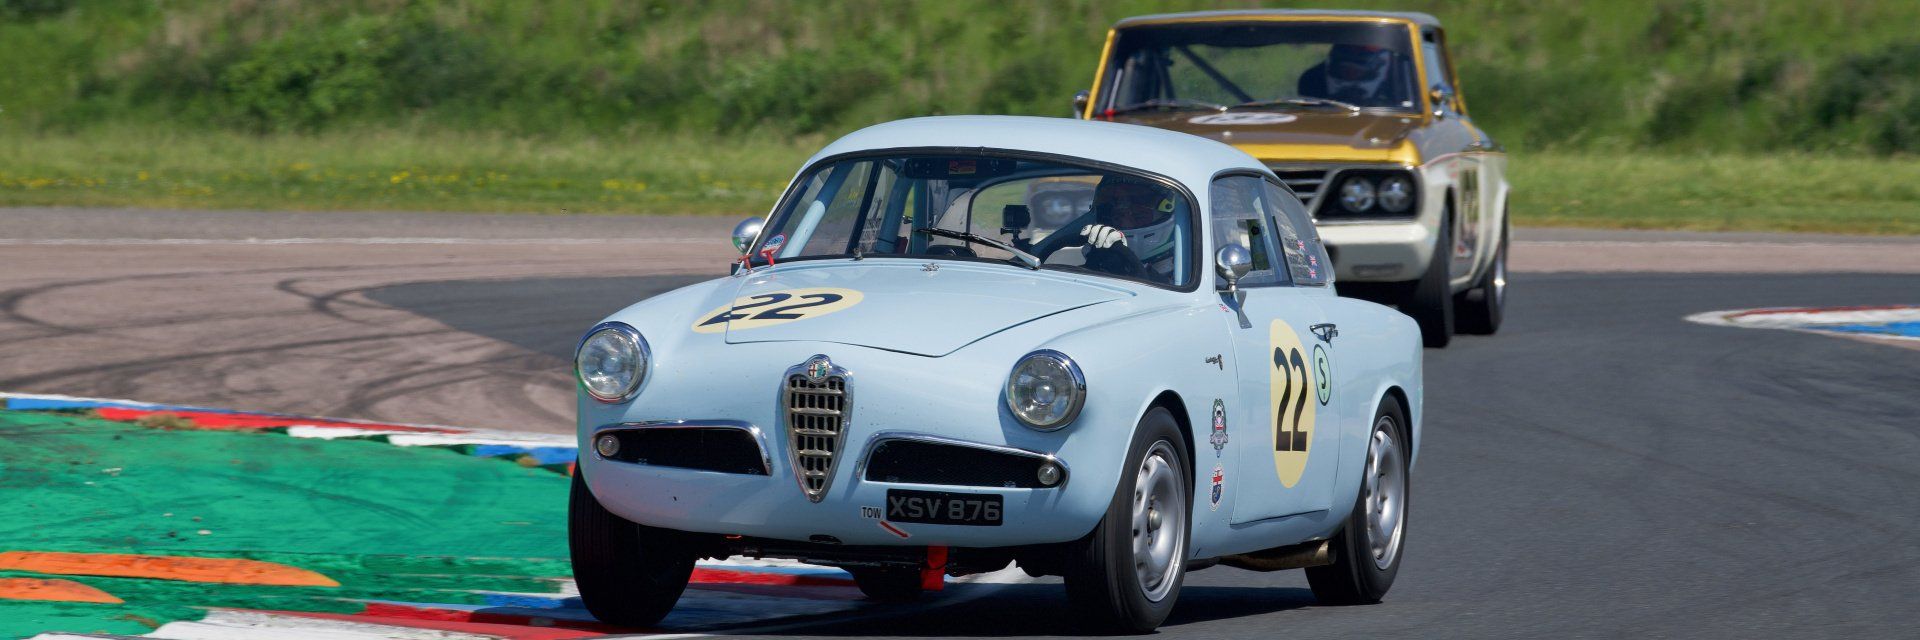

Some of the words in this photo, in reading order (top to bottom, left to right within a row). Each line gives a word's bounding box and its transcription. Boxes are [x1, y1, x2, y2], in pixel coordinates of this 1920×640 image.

[697, 293, 843, 327] 22
[1318, 357, 1326, 389] S
[1274, 346, 1308, 451] 22
[862, 507, 881, 519] TOW
[889, 496, 941, 518] XSV
[949, 499, 1000, 521] 876
